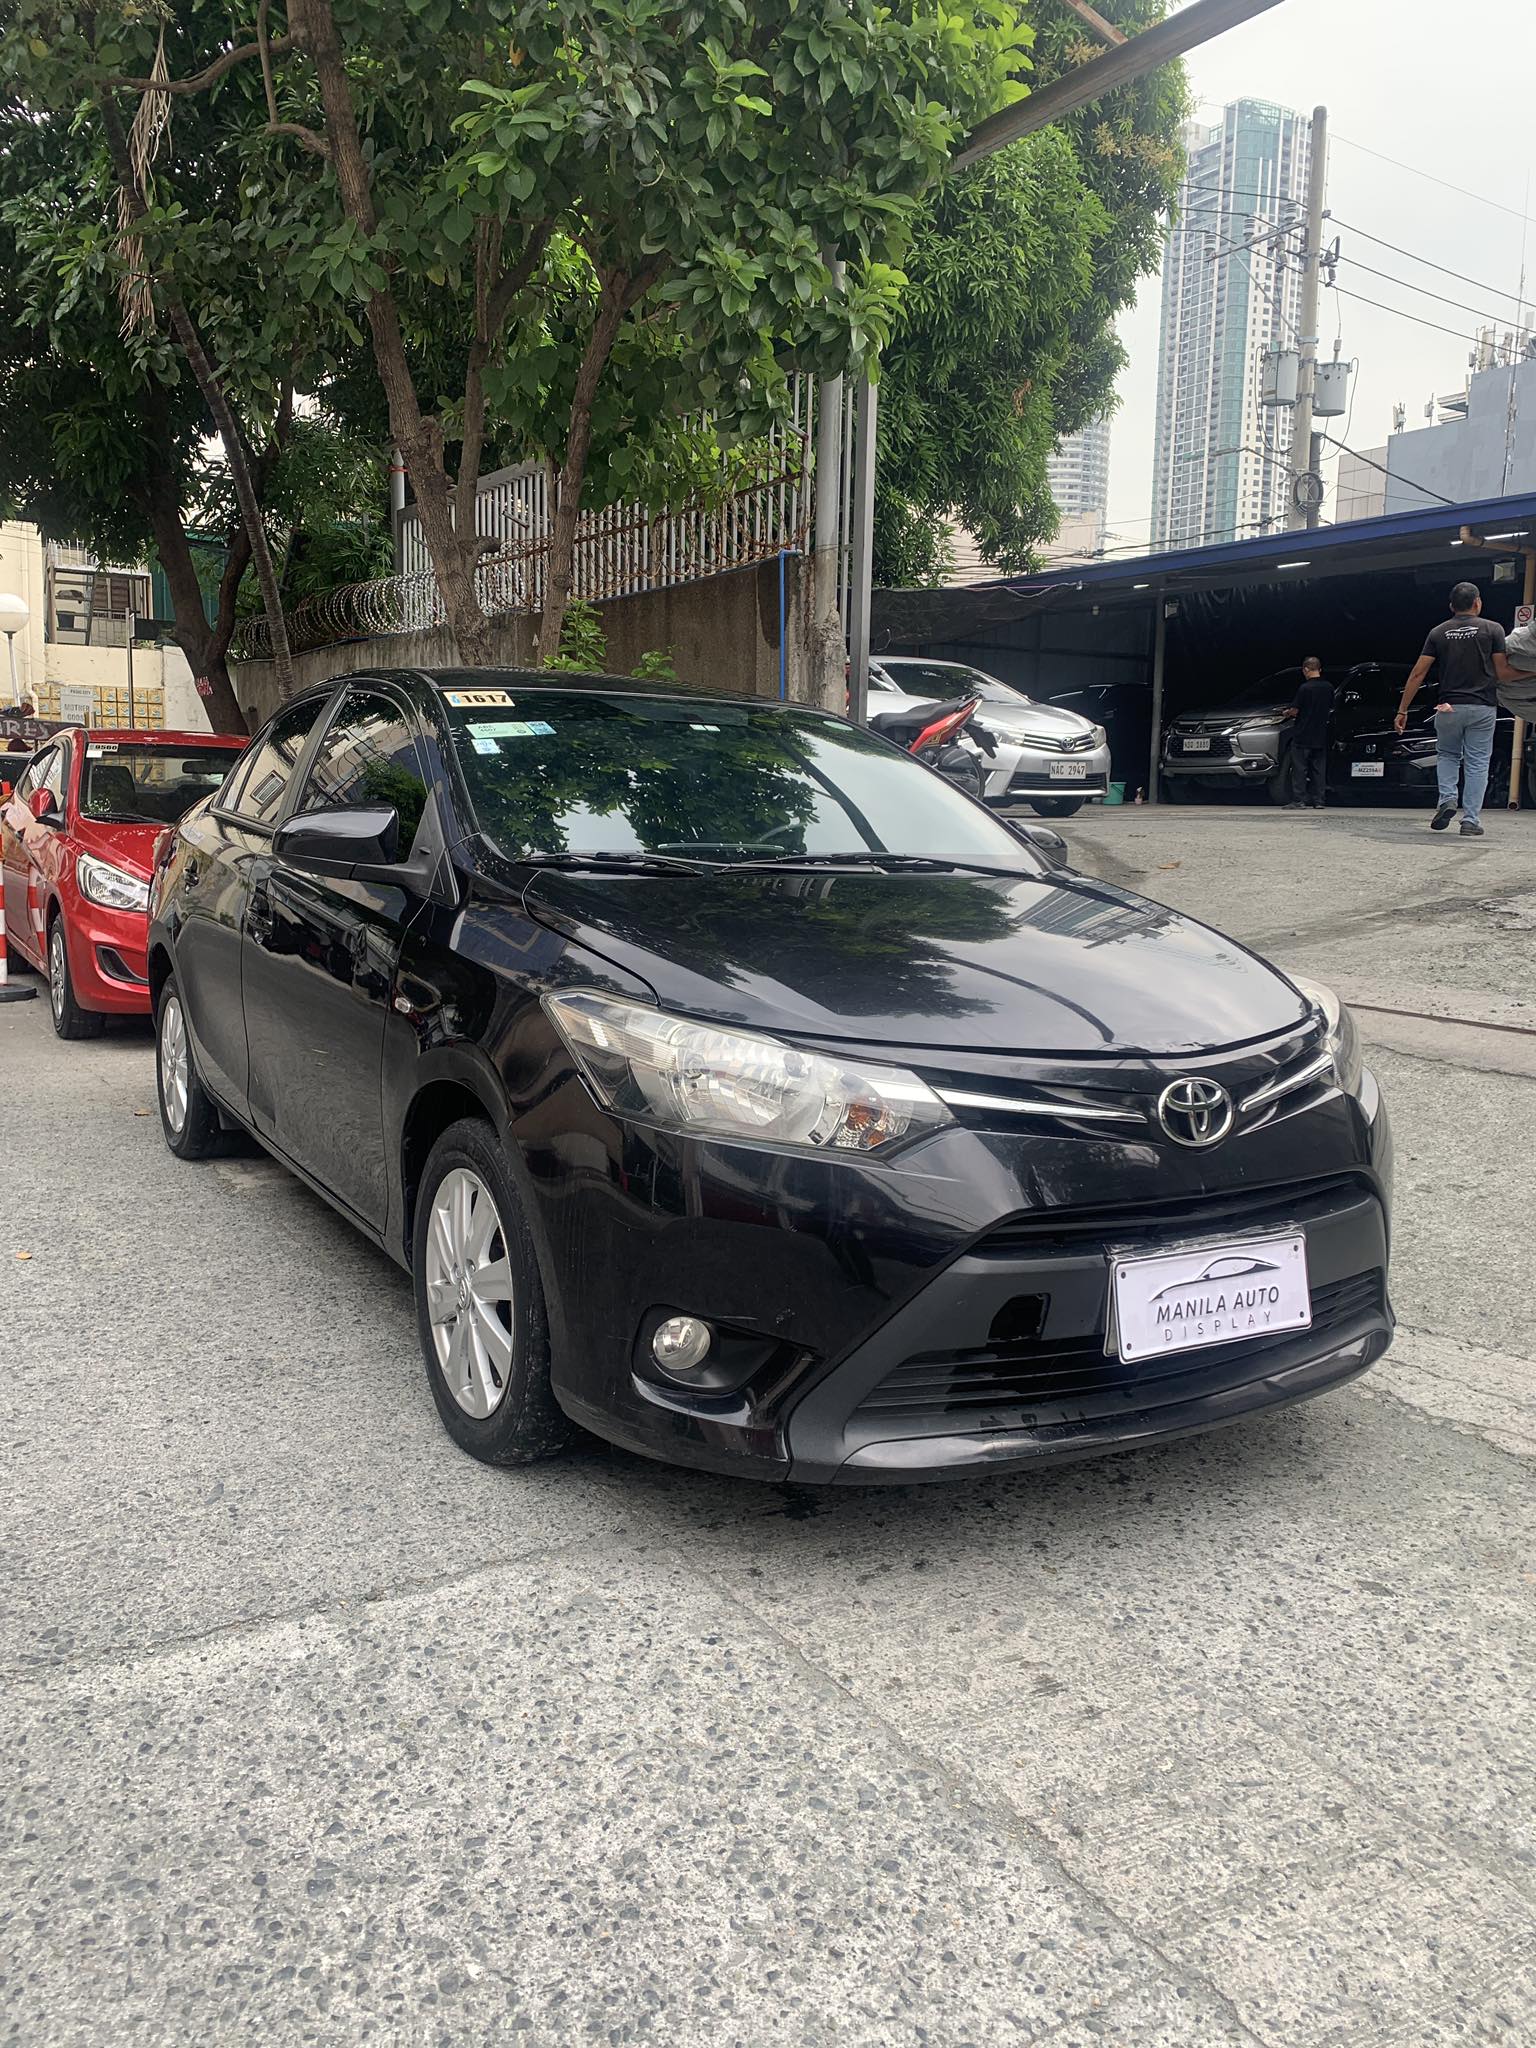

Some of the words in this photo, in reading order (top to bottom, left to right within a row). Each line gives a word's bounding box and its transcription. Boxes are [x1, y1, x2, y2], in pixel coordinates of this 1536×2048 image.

[461, 694, 507, 703] 1617
[1051, 765, 1064, 775] NAC
[1068, 765, 1086, 775] 2947
[1156, 1294, 1227, 1324] MANILA
[1233, 1286, 1279, 1310] AUTO
[1165, 1311, 1272, 1341] DISPLAY
